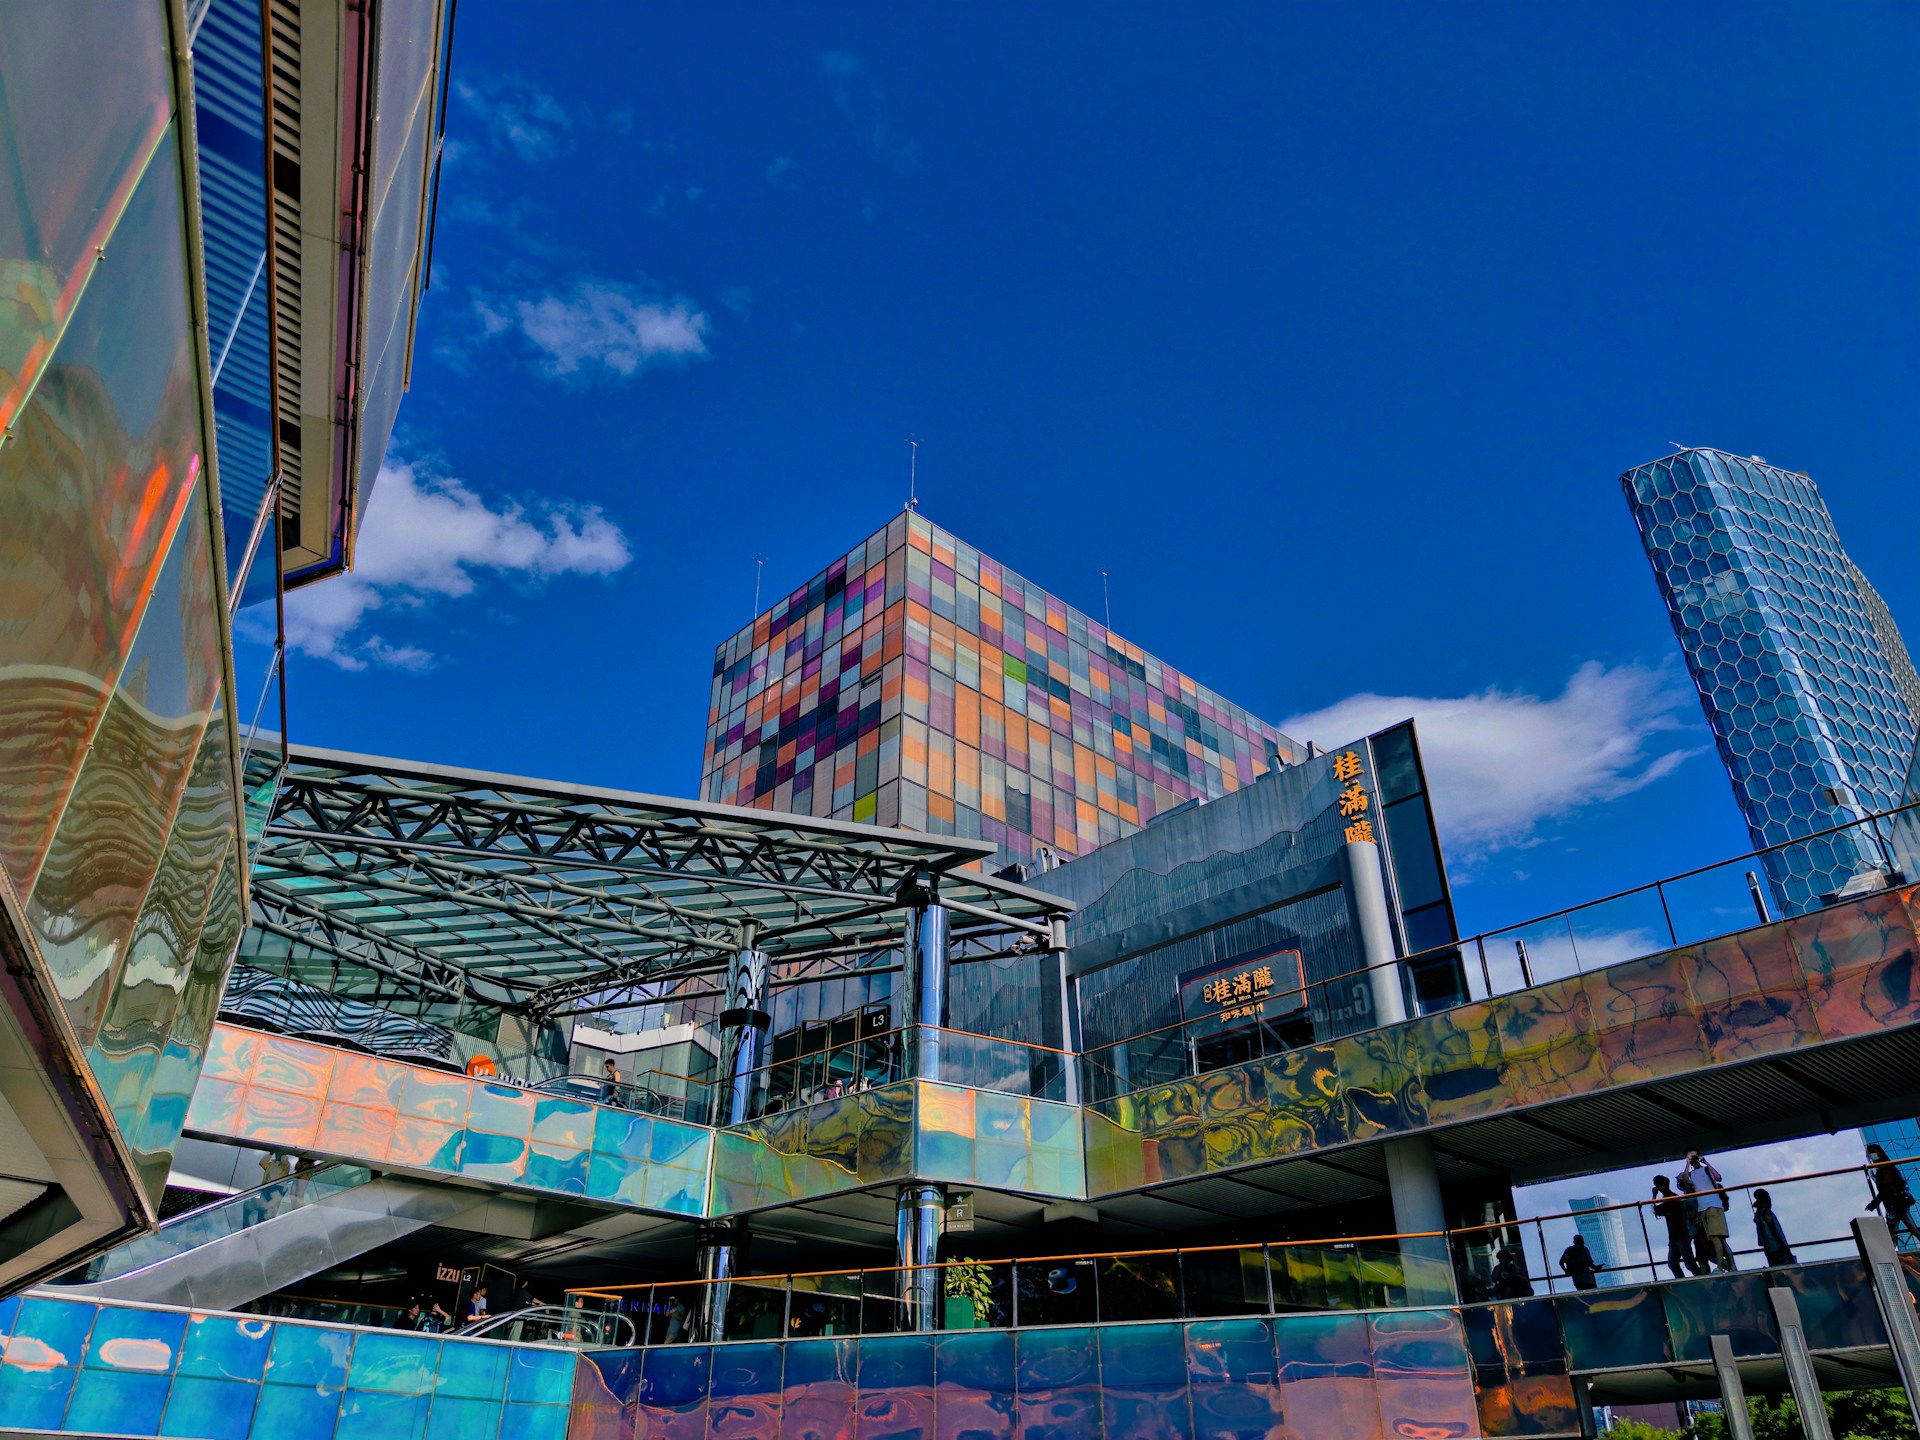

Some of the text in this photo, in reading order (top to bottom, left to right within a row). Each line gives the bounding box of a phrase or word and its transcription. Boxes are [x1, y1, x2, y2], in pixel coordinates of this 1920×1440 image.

[872, 1014, 885, 1027] L3
[956, 1209, 964, 1218] R
[436, 1262, 460, 1283] izzu
[463, 1274, 472, 1282] L2
